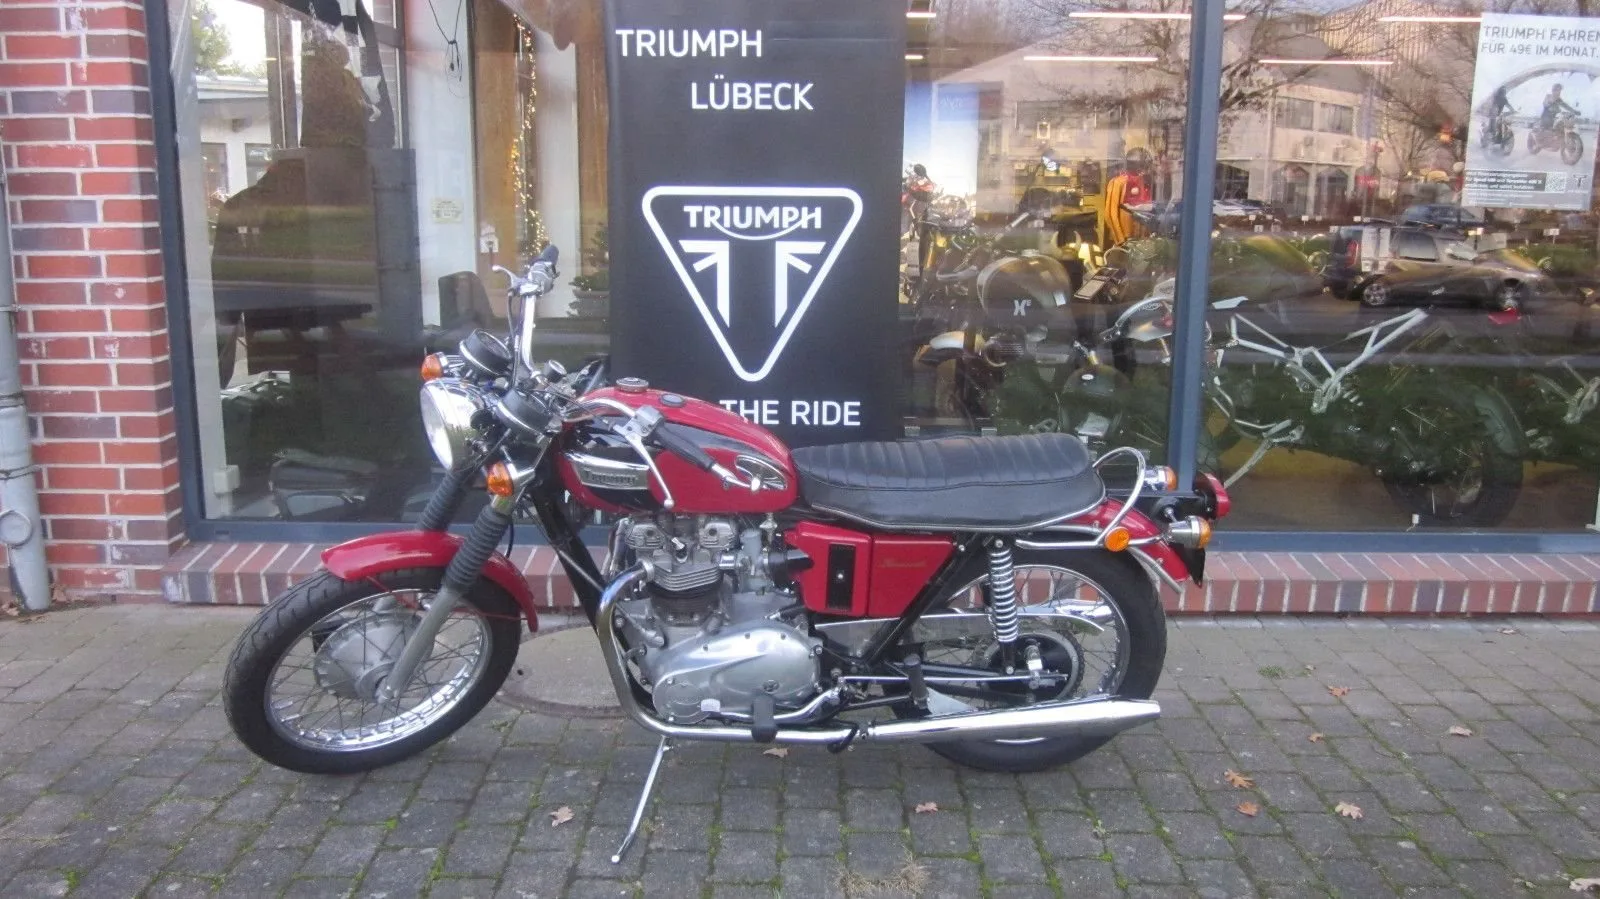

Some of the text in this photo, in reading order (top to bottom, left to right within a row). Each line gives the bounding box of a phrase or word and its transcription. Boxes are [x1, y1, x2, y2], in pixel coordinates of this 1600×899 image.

[615, 29, 762, 57] TRIUMPH
[1484, 25, 1545, 40] TRIUMPH
[1481, 39, 1599, 58] FÜR 49€ IM MONAT.
[691, 74, 814, 110] LÜBECK
[683, 205, 822, 232] TRIUMPH
[791, 400, 861, 426] RIDE
